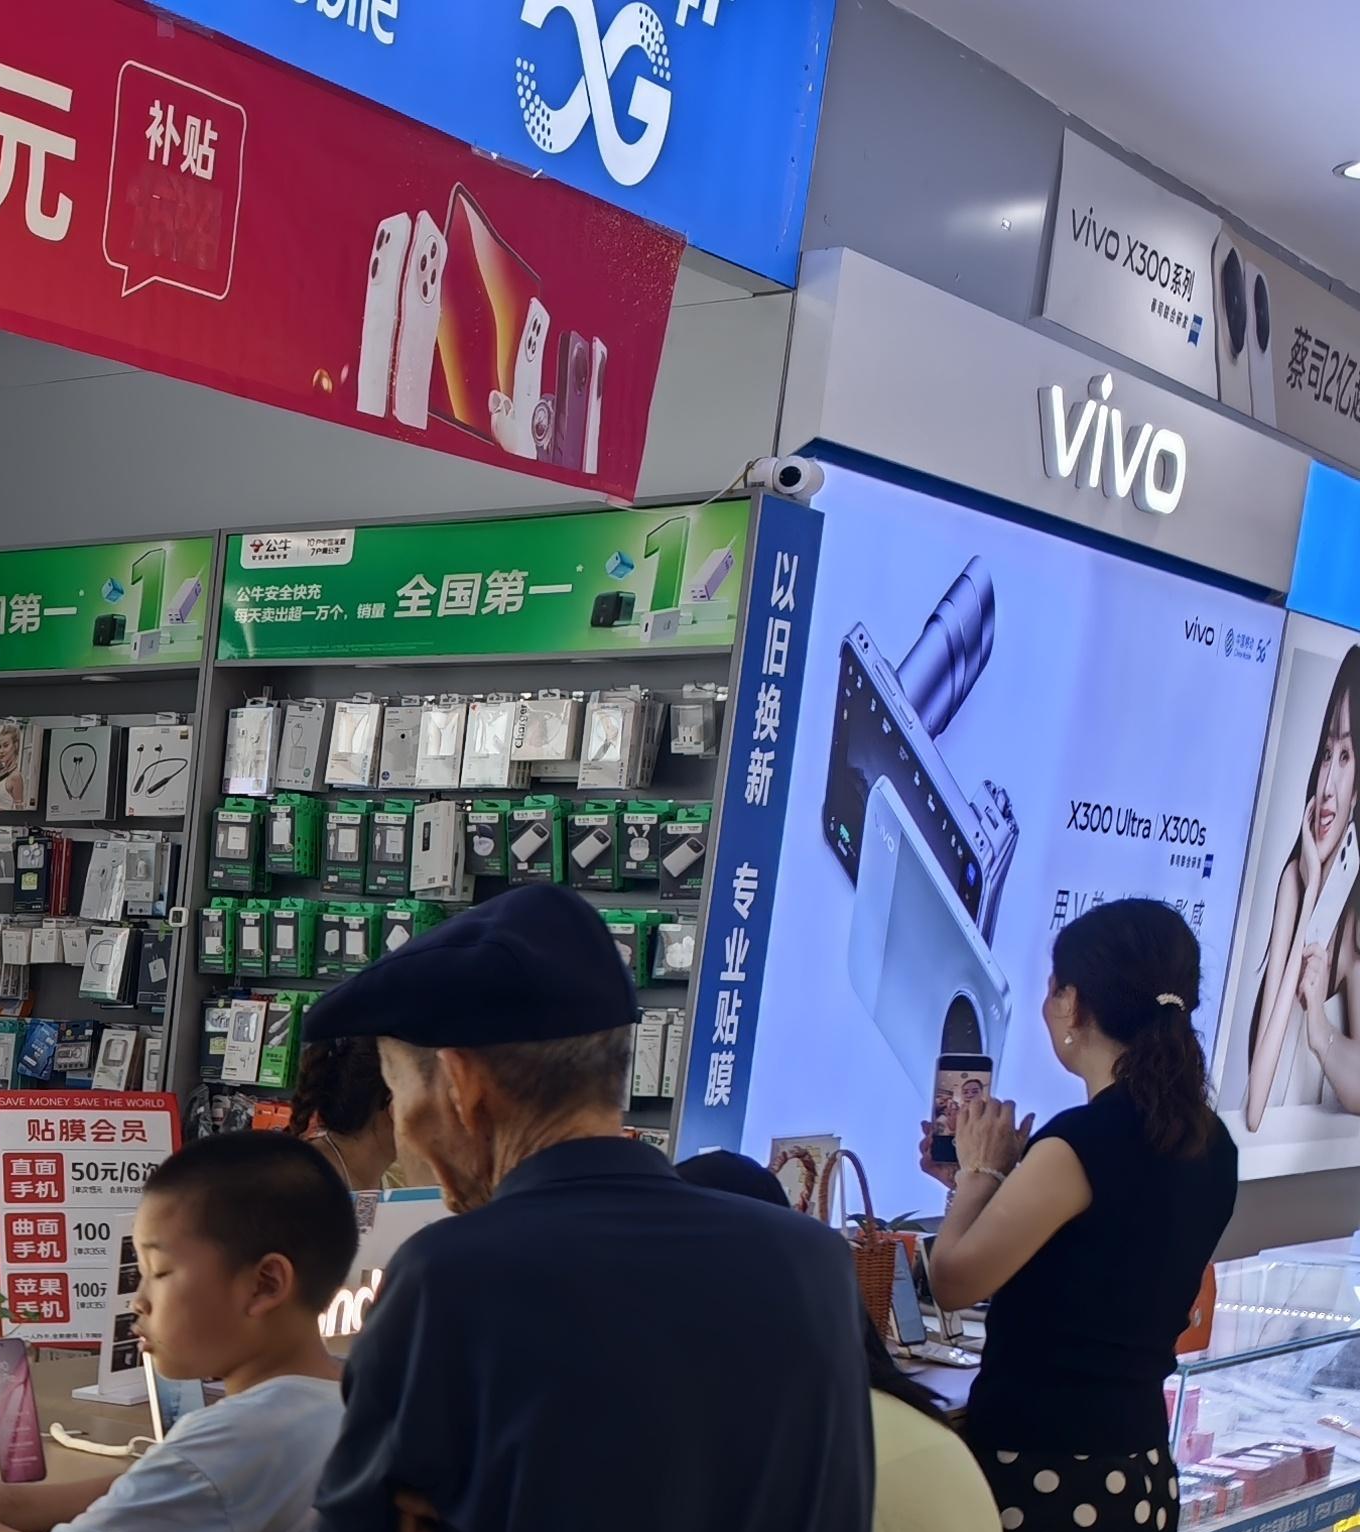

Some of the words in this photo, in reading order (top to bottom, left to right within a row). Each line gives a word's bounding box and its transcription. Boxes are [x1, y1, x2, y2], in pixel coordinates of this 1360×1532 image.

[145, 100, 219, 181] 补贴
[1072, 207, 1120, 262] vivo
[1122, 234, 1196, 302] X300系列
[1043, 372, 1186, 516] vivo
[266, 539, 292, 552] 公牛
[236, 583, 322, 603] 公牛安全快充
[393, 569, 573, 618] 全国第一
[1185, 616, 1215, 646] vivo
[744, 551, 800, 807] 以旧换新
[514, 704, 528, 749] Charger
[1066, 800, 1113, 834] X300
[1116, 808, 1152, 839] Ultra
[1158, 814, 1207, 847] X300s
[703, 861, 760, 1109] 专业贴膜
[30, 1097, 70, 1107] MONEY
[73, 1097, 100, 1107] SAVE
[103, 1098, 122, 1107] THE
[126, 1098, 165, 1108] WORLD
[27, 1119, 148, 1143] 贴膜会员
[10, 1158, 57, 1176] 直面
[10, 1180, 58, 1199] 手机
[12, 1218, 59, 1236] 曲面
[72, 1222, 111, 1241] 100
[12, 1241, 61, 1259] 手机
[14, 1278, 63, 1296] 苹果
[15, 1301, 64, 1318] 手机
